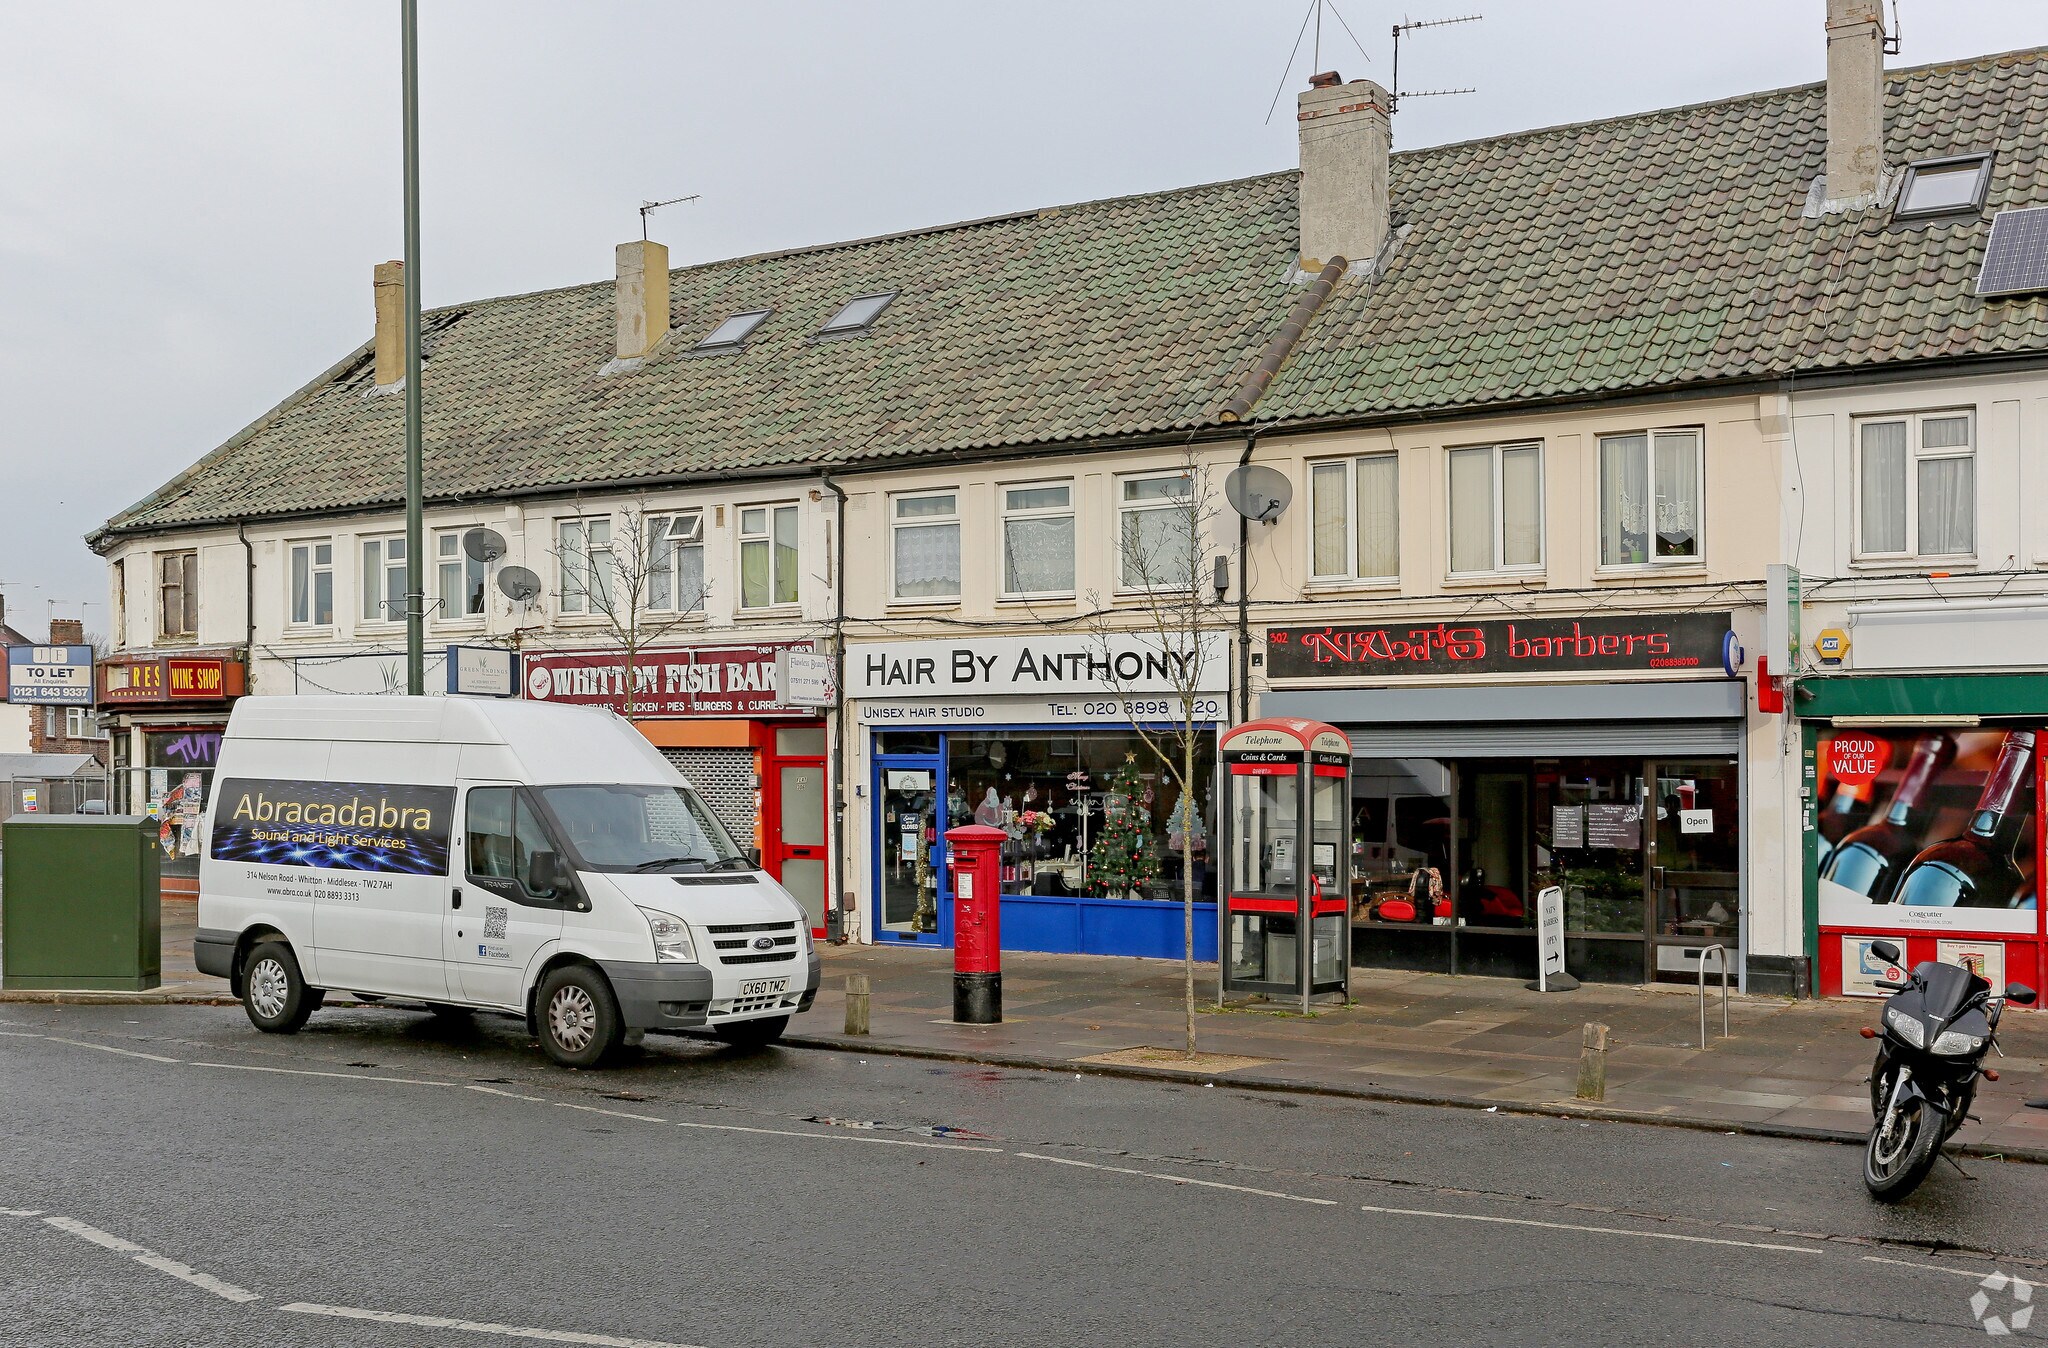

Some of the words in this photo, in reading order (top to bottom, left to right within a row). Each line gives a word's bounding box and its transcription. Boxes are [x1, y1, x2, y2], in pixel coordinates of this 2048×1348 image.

[1270, 633, 1288, 644] 302
[1508, 622, 1670, 658] barbers
[26, 668, 44, 678] TO
[50, 668, 74, 678] LET
[866, 653, 936, 686] HAIR
[952, 650, 998, 683] BY
[1012, 648, 1196, 682] ANTHONY
[172, 668, 194, 689] WINE
[198, 668, 220, 690] SHOP
[551, 665, 659, 696] WHITTON
[665, 663, 721, 694] FISH
[726, 662, 777, 692] BAR
[14, 688, 37, 696] 0121
[41, 688, 60, 696] 643
[62, 688, 88, 696] 9337
[667, 702, 684, 712] PIES
[694, 702, 732, 711] BURGERS
[738, 702, 744, 710] &
[864, 706, 904, 718] UNISEX
[910, 708, 936, 718] HAIR
[942, 707, 984, 718] STUDIO
[1048, 704, 1077, 716] TEL:
[1084, 702, 1116, 715] 020
[1124, 702, 1168, 714] 8898
[1180, 700, 1218, 713] 120
[1245, 736, 1282, 746] Telephone
[1321, 737, 1340, 748] Telephone
[1834, 740, 1874, 752] PROUD
[1240, 753, 1260, 761] Coins
[1266, 754, 1286, 762] Cards
[1320, 754, 1328, 762] Coins
[1332, 756, 1342, 764] Cards
[1833, 760, 1876, 774] VALUE
[232, 792, 432, 830] Abracadabra
[1686, 818, 1708, 826] Open
[251, 828, 289, 842] Sound
[292, 830, 315, 844] and
[318, 831, 349, 848] Light
[352, 834, 406, 849] Services
[246, 870, 258, 880] 314
[258, 872, 278, 881] Nelson
[279, 873, 294, 882] Road
[298, 874, 322, 884] Whitton
[327, 877, 358, 888] Middlesex
[362, 880, 378, 888] TW2
[379, 880, 392, 890] 7AH
[484, 880, 514, 889] TRANSIT
[267, 888, 312, 898] www.abra.co.uk
[314, 890, 326, 898] 020
[327, 890, 342, 900] 8893
[344, 892, 360, 902] 3313
[1546, 935, 1558, 946] OPEN
[743, 982, 766, 996] CX60
[769, 980, 786, 992] TMZ
